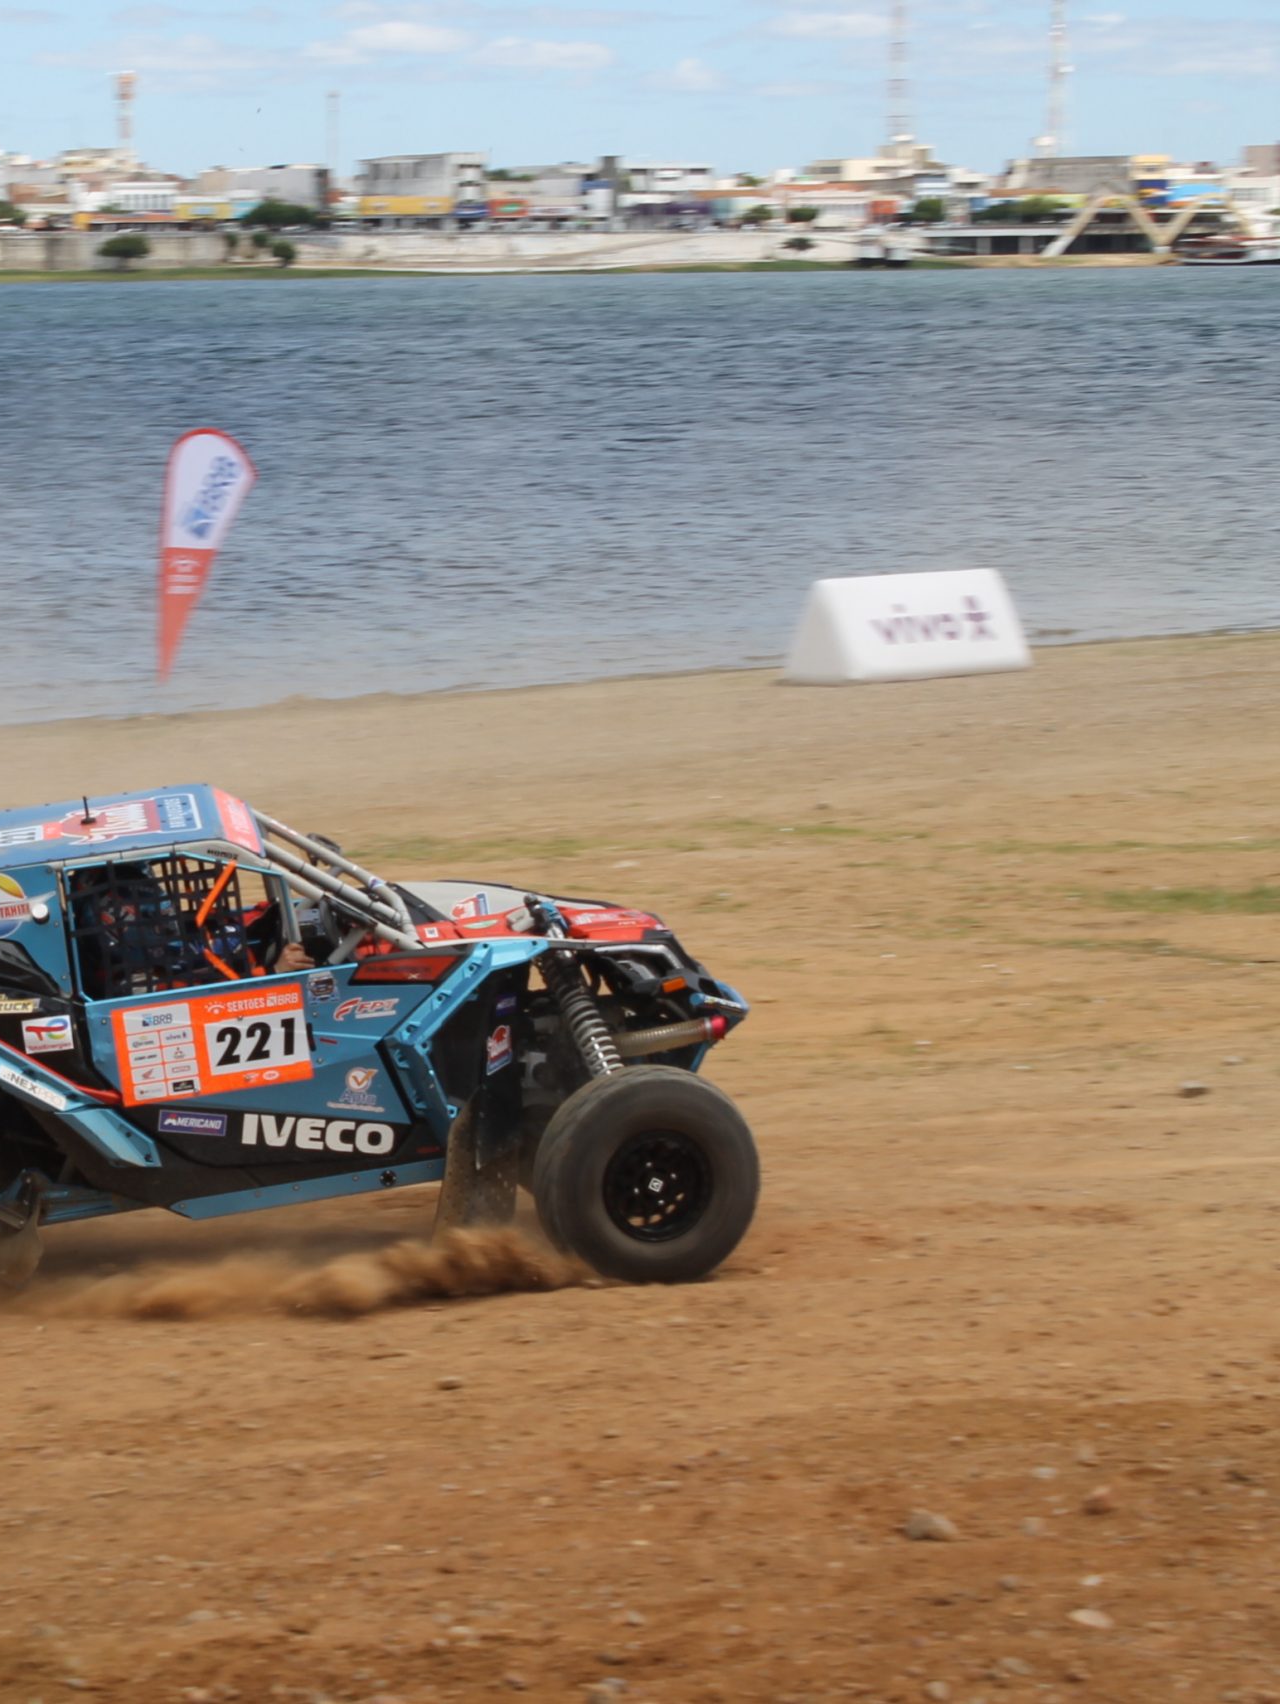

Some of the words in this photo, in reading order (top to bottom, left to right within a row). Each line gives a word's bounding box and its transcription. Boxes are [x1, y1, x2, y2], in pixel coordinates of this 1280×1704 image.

[0, 902, 30, 918] TAHITI
[153, 1013, 173, 1026] BRB
[216, 1017, 295, 1067] 221
[164, 1113, 222, 1129] AMERICANO
[241, 1113, 395, 1155] IVECO
